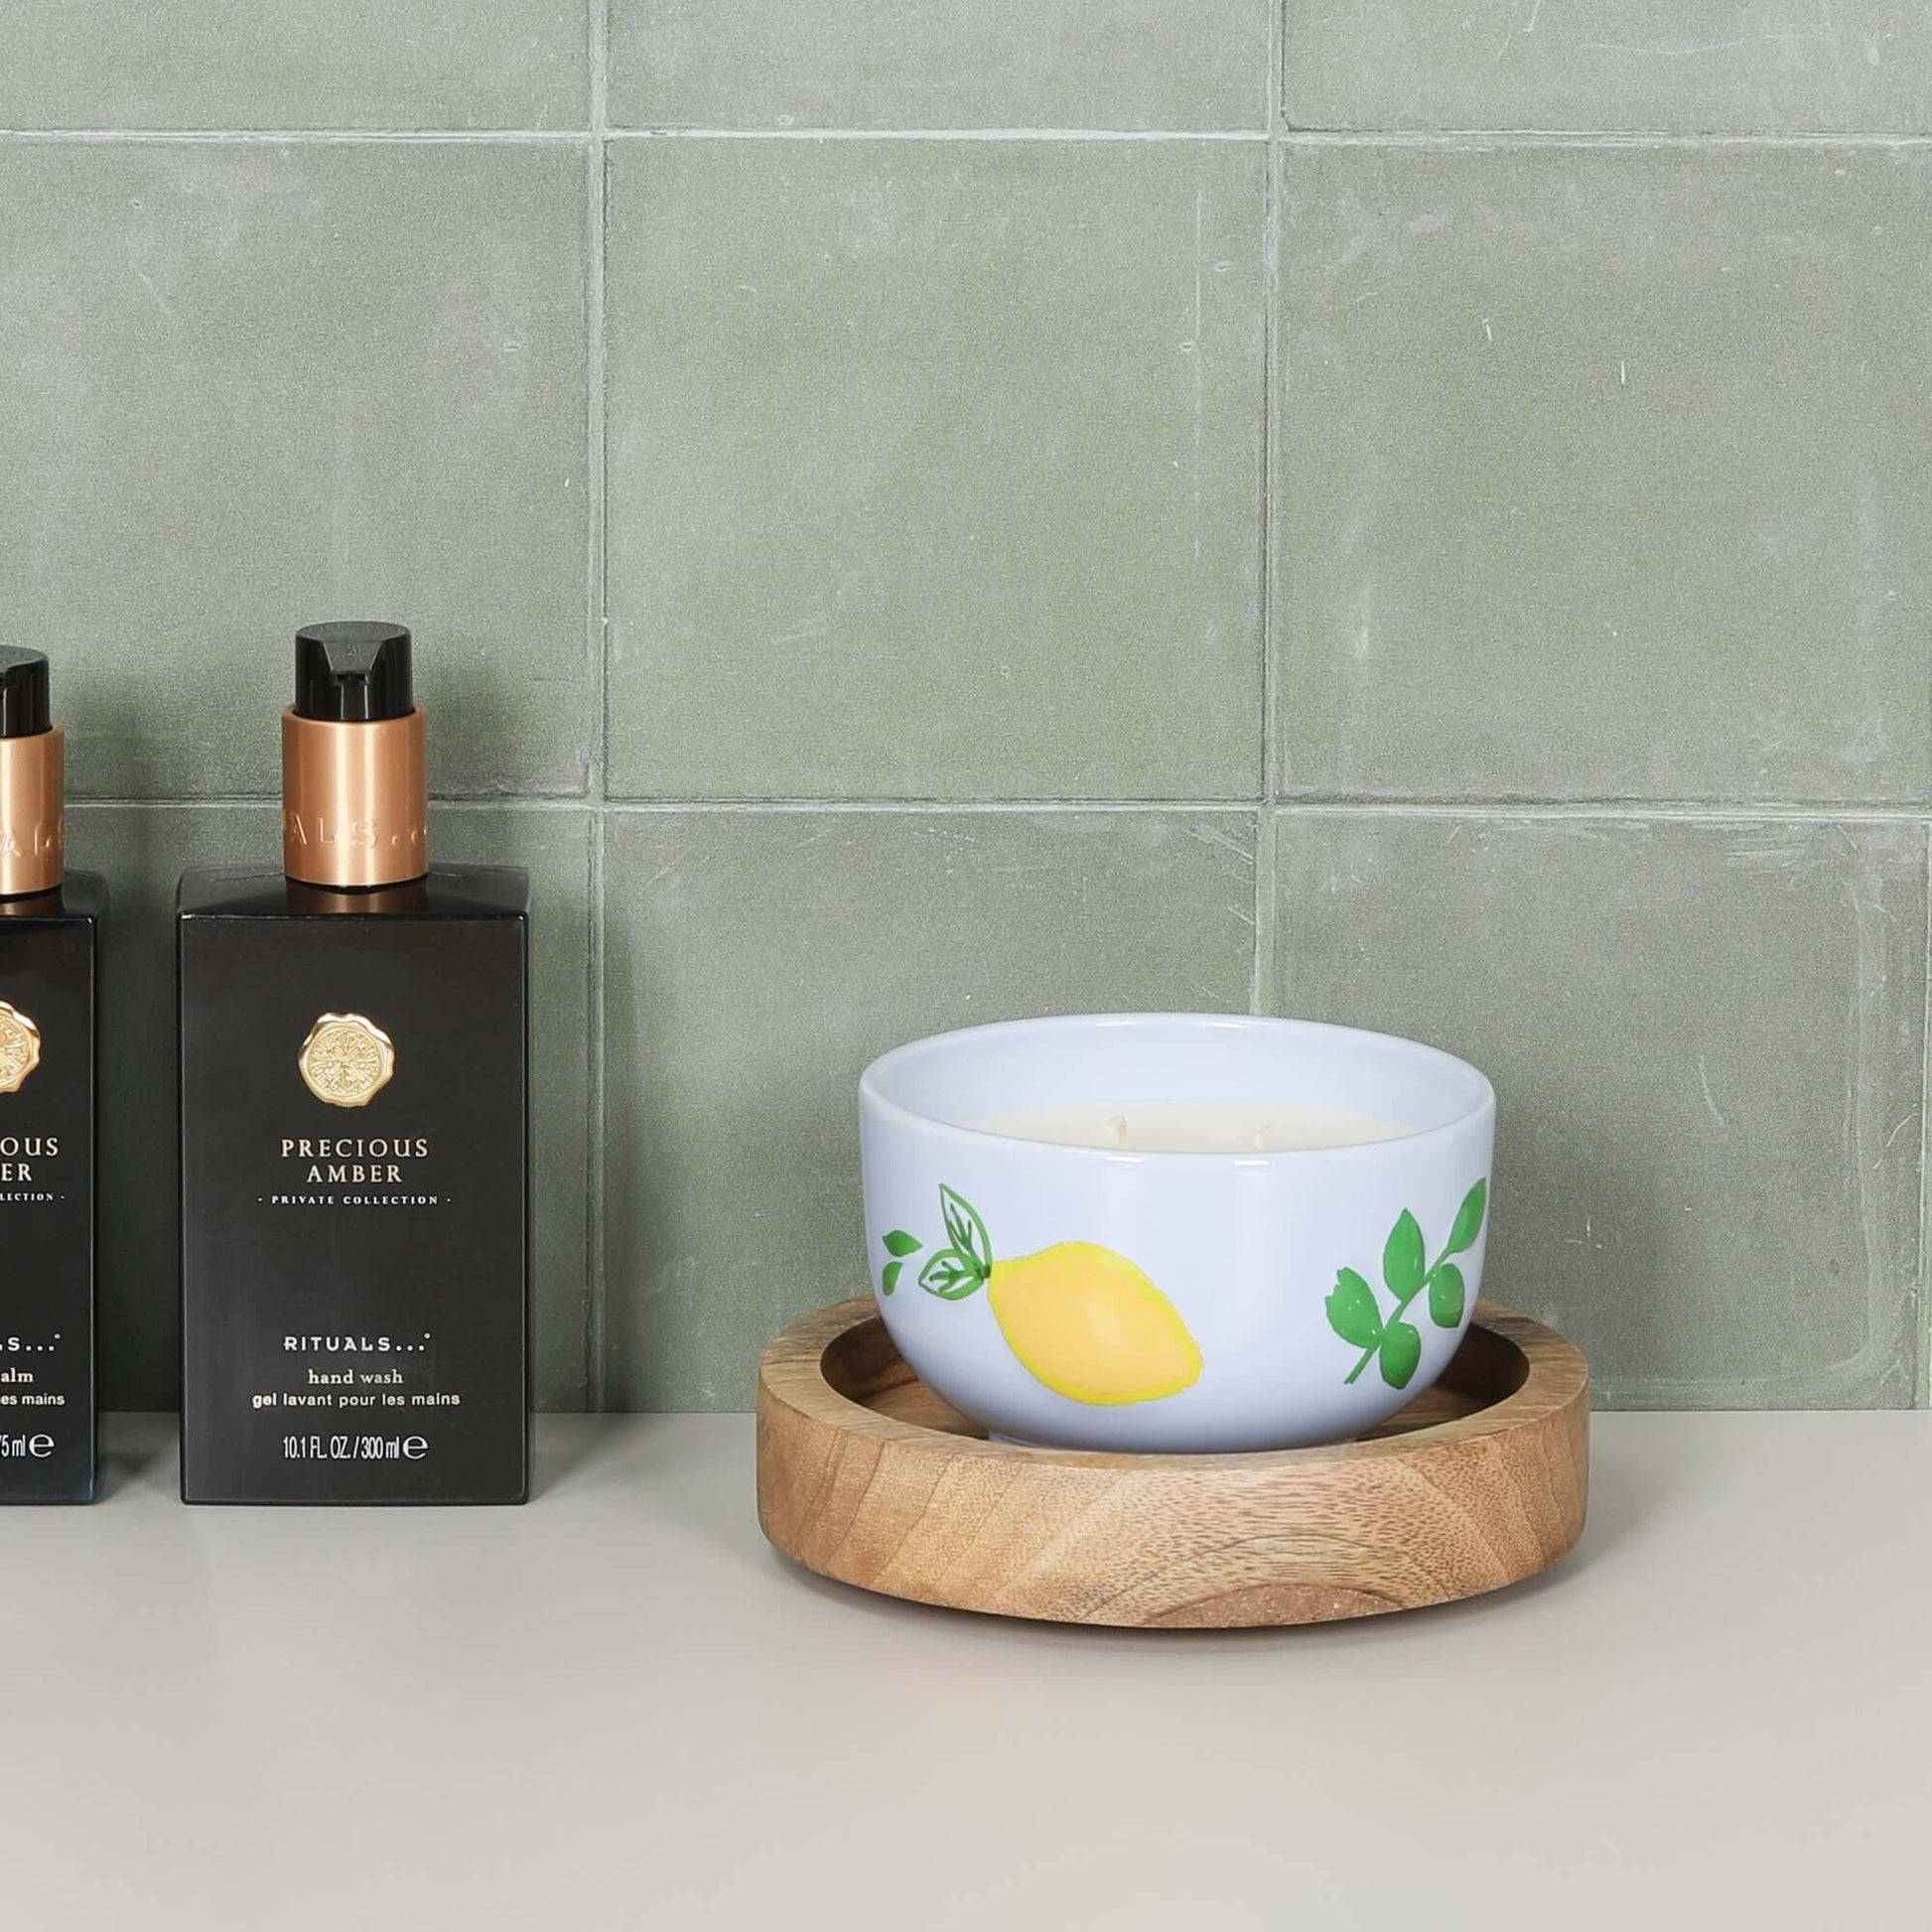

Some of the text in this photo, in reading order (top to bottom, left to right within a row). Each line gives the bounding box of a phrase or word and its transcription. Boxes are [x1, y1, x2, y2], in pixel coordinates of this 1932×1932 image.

[0, 1137, 60, 1158] OUS
[281, 1138, 428, 1158] PRECIOUS
[1, 1163, 33, 1181] ER
[306, 1164, 403, 1183] AMBER
[271, 1194, 438, 1205] PRIVATE COLLECTION
[0, 1367, 34, 1383] alm
[307, 1368, 404, 1385] hand wash
[21, 1392, 66, 1406] mains
[251, 1392, 462, 1410] gel lavant pour les mains
[282, 1436, 307, 1459] 10.1
